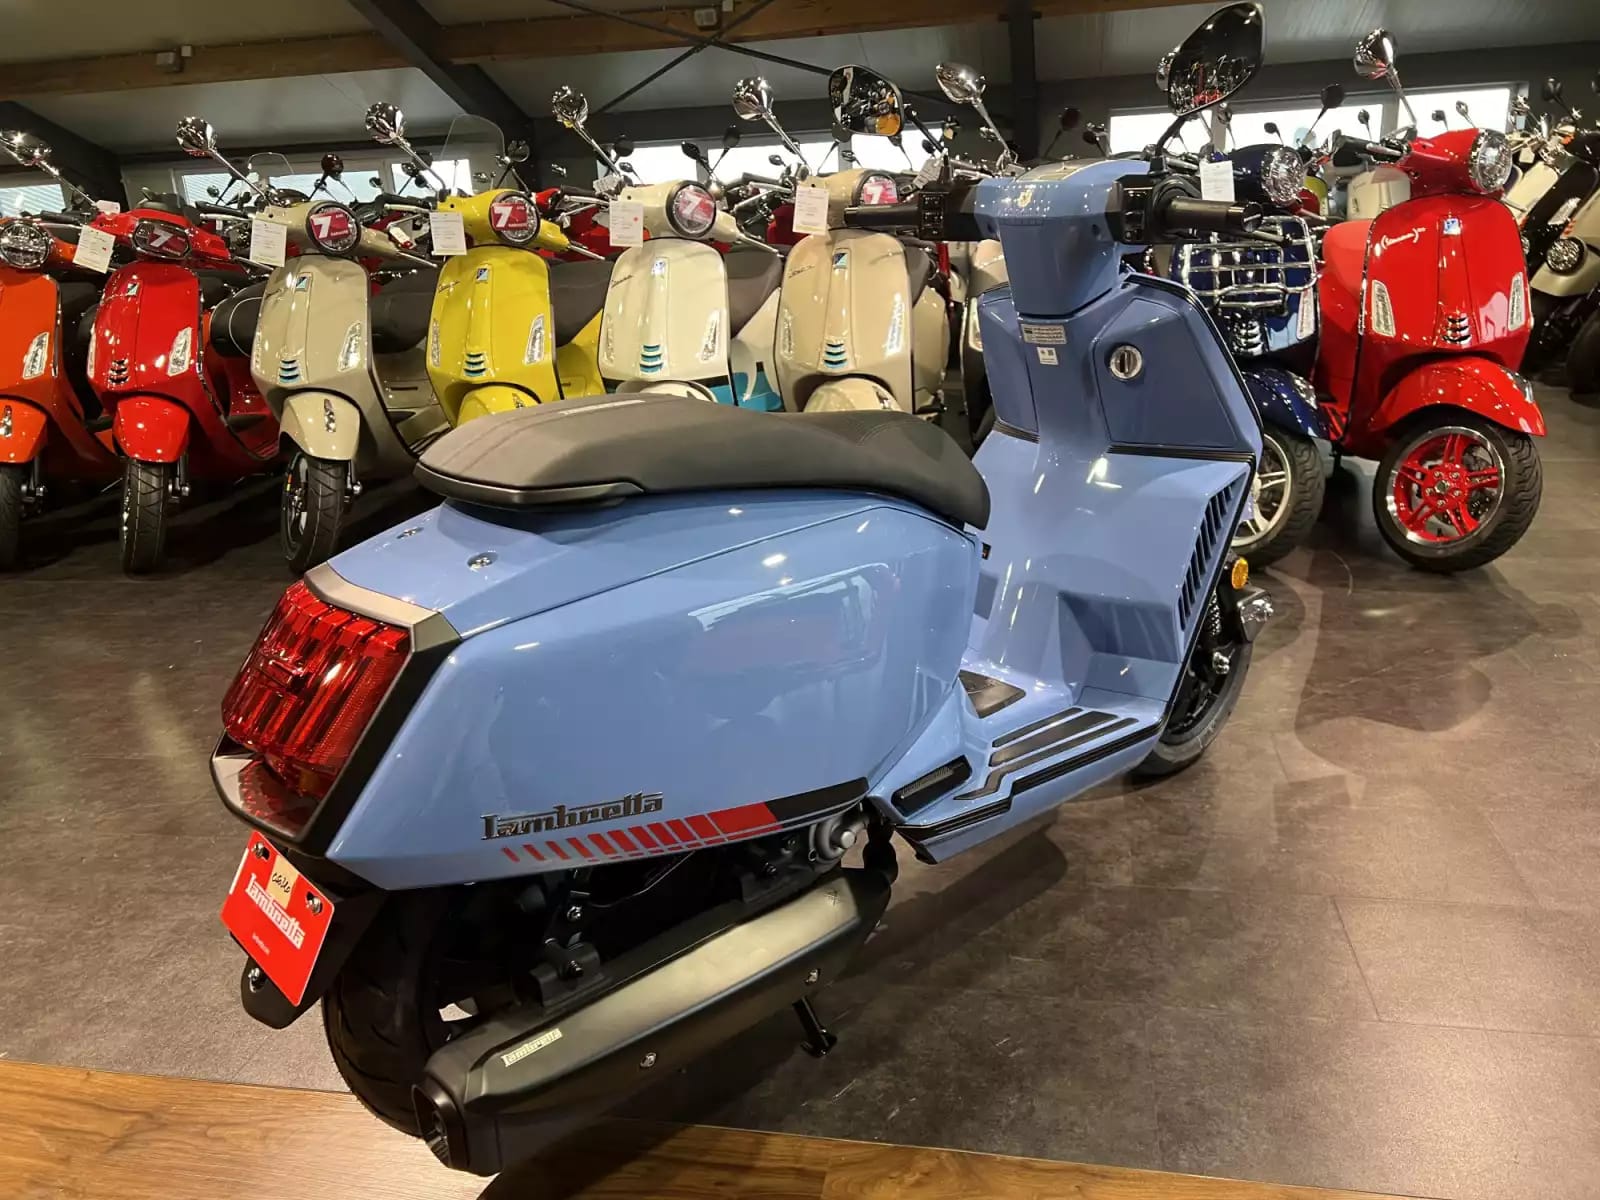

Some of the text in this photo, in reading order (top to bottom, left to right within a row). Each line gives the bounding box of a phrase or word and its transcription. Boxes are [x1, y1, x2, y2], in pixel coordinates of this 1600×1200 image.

[313, 215, 332, 239] 7
[494, 206, 513, 228] 7
[150, 226, 174, 248] 7
[481, 790, 664, 840] Lambretta
[245, 873, 306, 950] Lambretta
